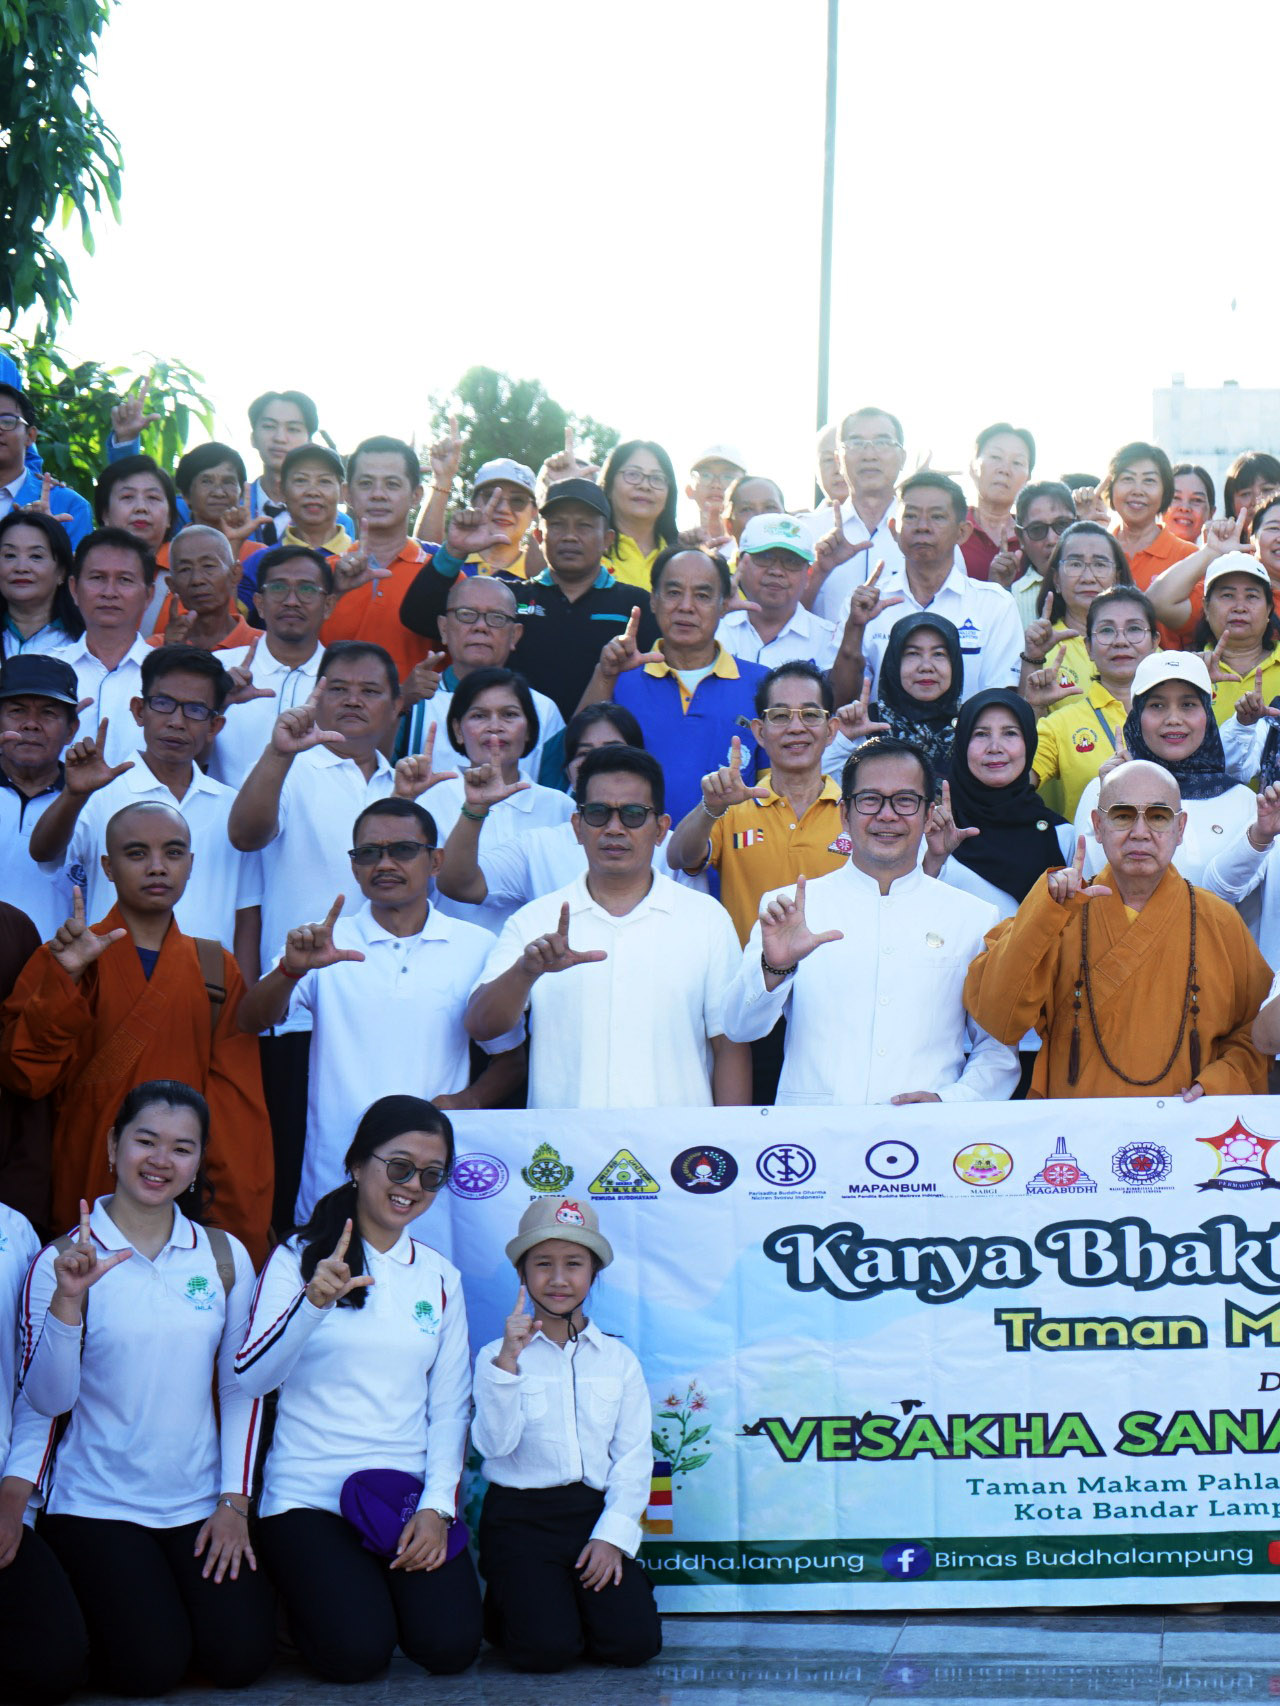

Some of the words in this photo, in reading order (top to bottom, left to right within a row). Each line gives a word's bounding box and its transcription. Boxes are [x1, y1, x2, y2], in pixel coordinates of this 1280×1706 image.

[848, 1183, 937, 1194] MAPANBUMI
[1026, 1187, 1098, 1195] MAGABUDHI
[769, 1223, 1035, 1300] Karya
[997, 1308, 1207, 1350] Taman
[760, 1411, 1107, 1463] VESAKHA
[966, 1477, 1067, 1497] Taman
[1077, 1474, 1187, 1495] Makam
[1014, 1501, 1082, 1521] Kota
[1093, 1500, 1202, 1520] Bandar
[935, 1550, 1017, 1569] Bimas
[1026, 1545, 1253, 1568] Buddhalampung
